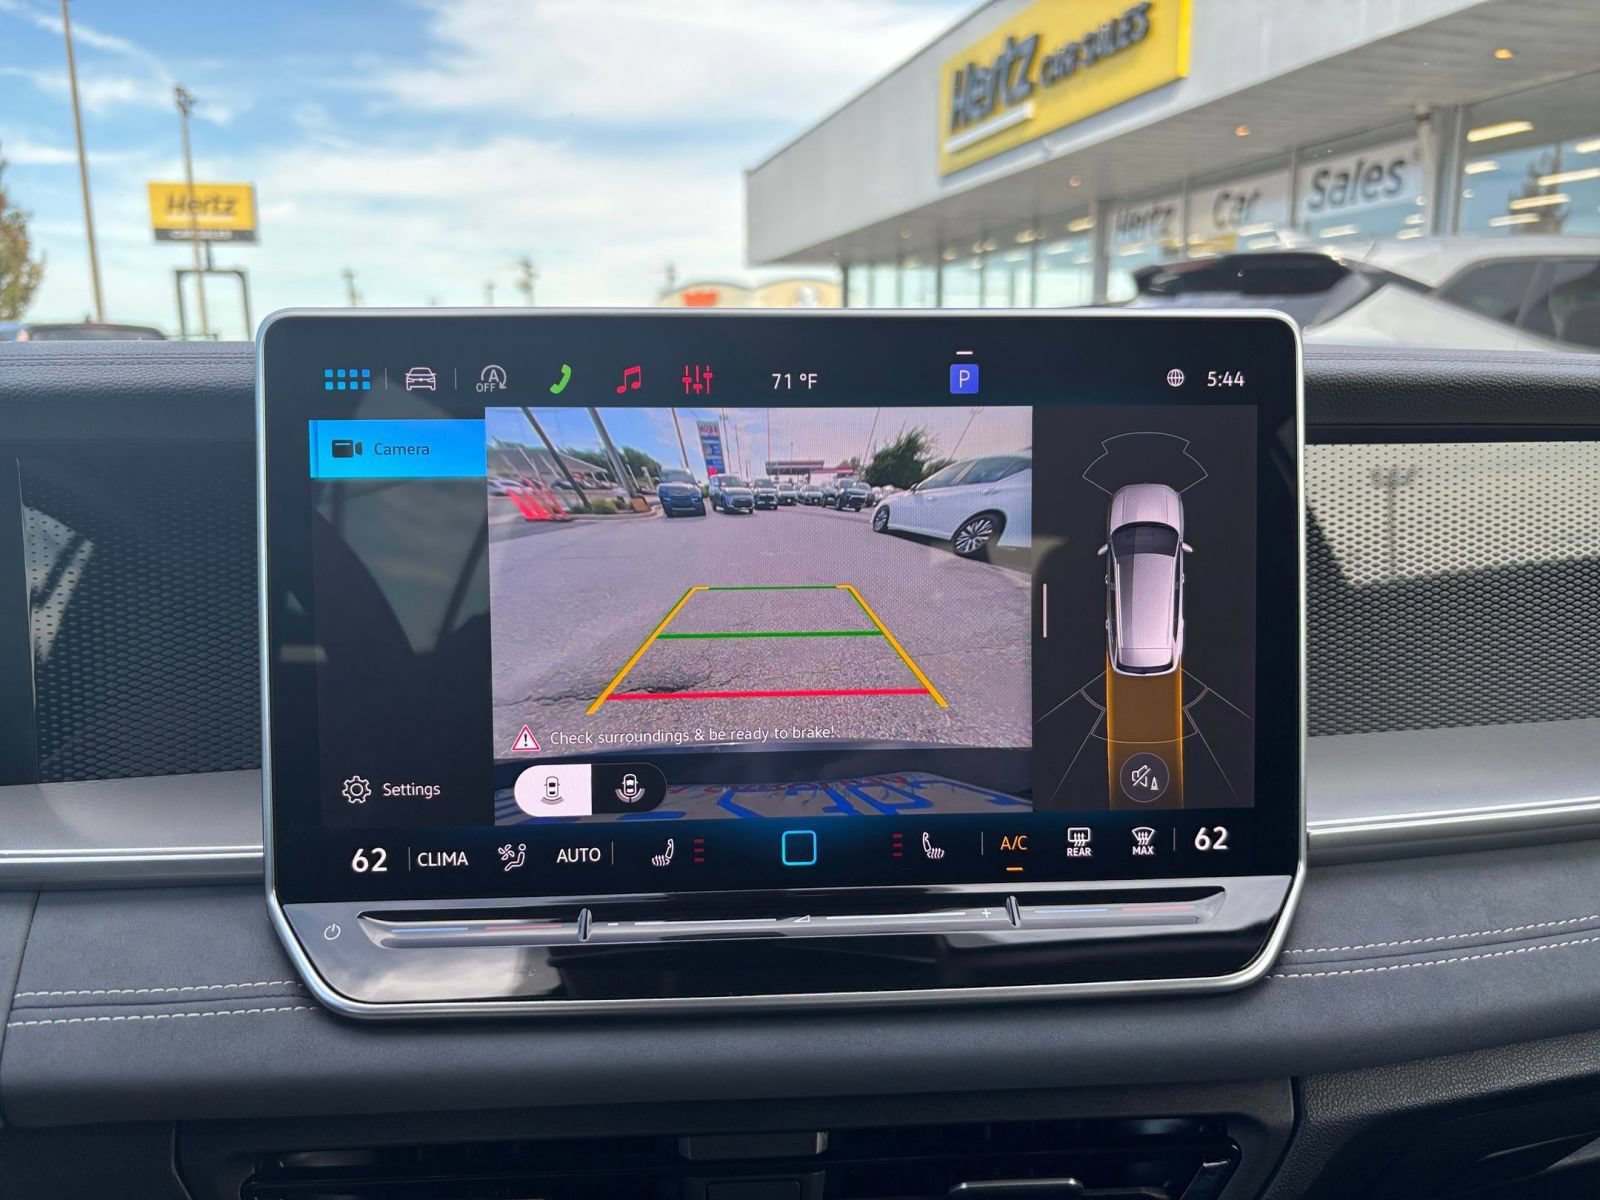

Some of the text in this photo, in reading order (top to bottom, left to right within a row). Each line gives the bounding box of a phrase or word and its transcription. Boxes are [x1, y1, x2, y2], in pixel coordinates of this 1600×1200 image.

[952, 33, 1040, 133] Hertz
[1211, 185, 1262, 229] Car
[1306, 155, 1405, 212] Sales
[165, 191, 237, 217] Hertz
[475, 383, 496, 392] OFF
[771, 373, 792, 390] 71
[959, 370, 970, 388] P
[1207, 371, 1244, 387] 5:44
[374, 442, 430, 455] Camera
[550, 725, 834, 745] Check surroundings & be ready to brake!
[383, 782, 441, 799] Settings
[1000, 835, 1028, 850] A/C
[1194, 826, 1228, 850] 62
[417, 851, 469, 867] CLIMA
[556, 847, 601, 863] AUTO
[1066, 847, 1092, 857] REAR
[1132, 846, 1155, 855] MAX
[352, 847, 388, 872] 62
